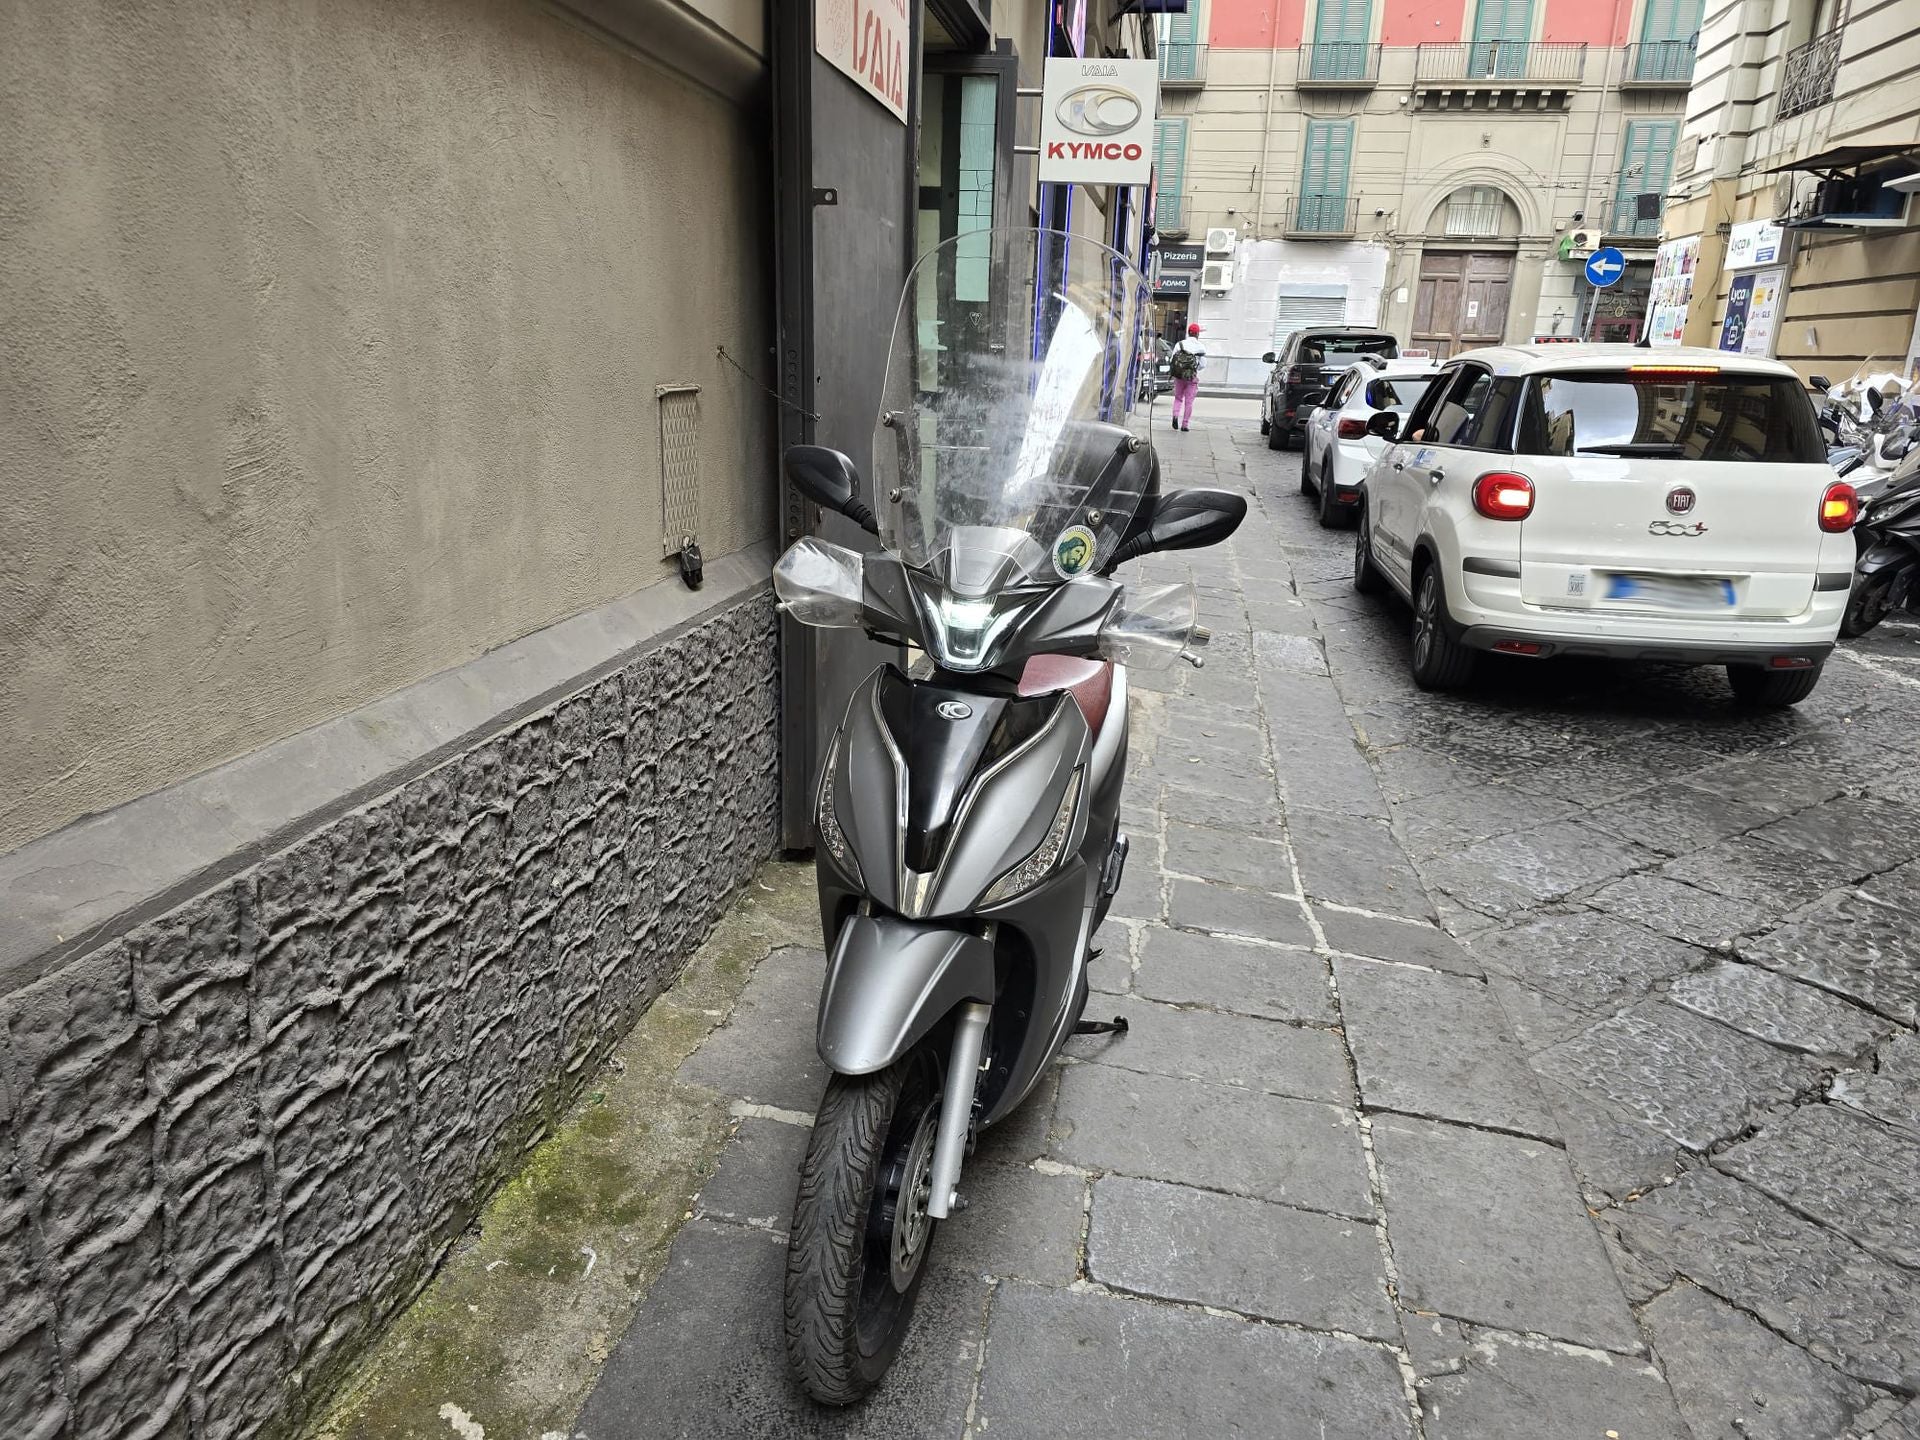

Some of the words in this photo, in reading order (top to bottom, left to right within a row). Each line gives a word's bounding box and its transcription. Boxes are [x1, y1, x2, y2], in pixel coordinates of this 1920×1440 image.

[853, 0, 903, 111] ISAIA
[1081, 65, 1118, 76] ISAIA
[1047, 142, 1142, 160] KYMCO
[1164, 252, 1197, 260] Pizzeria
[1731, 287, 1746, 303] Lyca
[1673, 494, 1691, 508] FIAT
